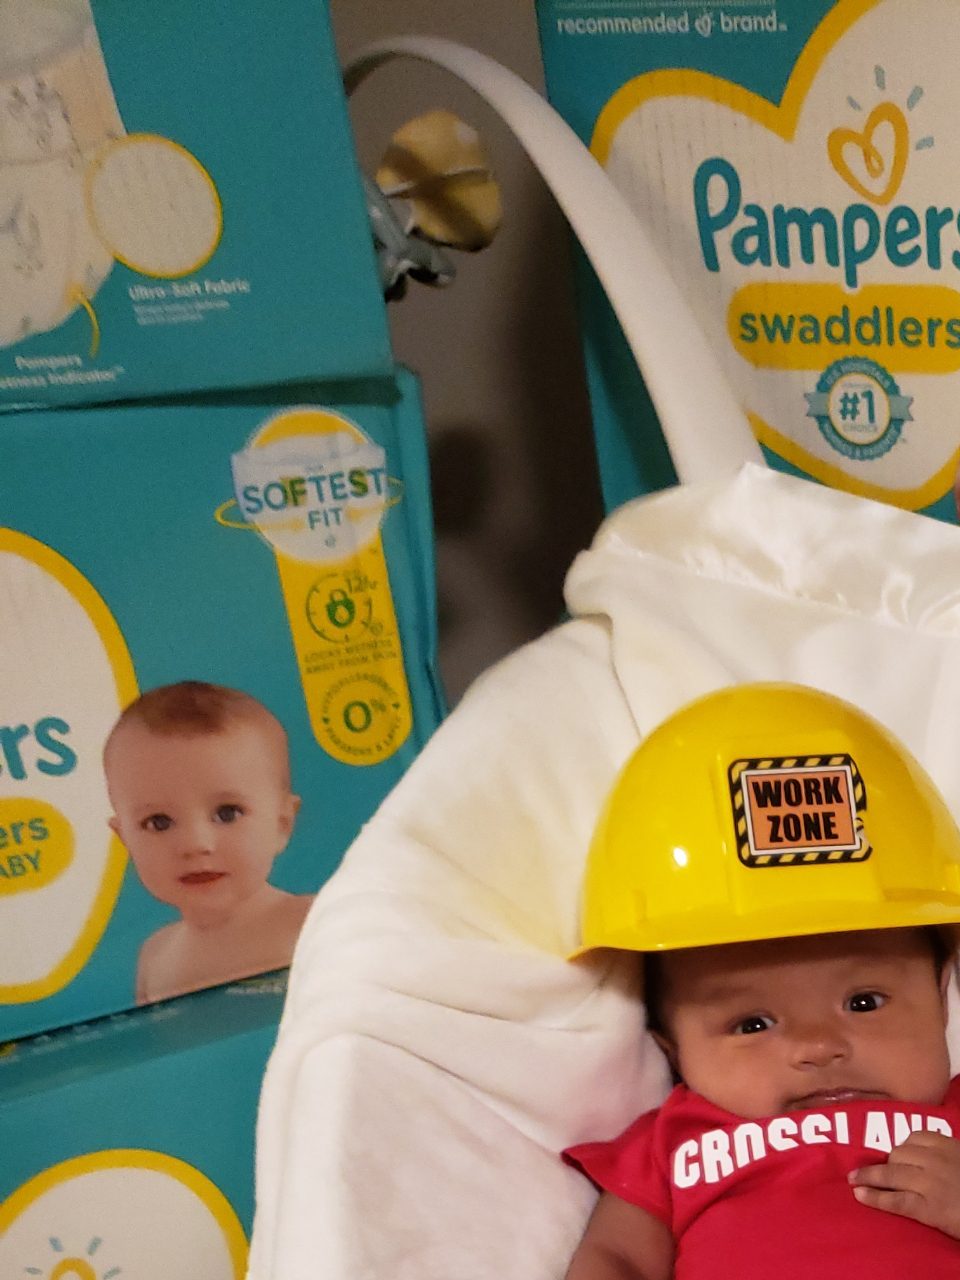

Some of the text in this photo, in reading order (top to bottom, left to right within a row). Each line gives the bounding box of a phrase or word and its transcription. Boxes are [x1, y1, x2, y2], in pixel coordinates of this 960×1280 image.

[557, 12, 689, 34] recommended
[839, 389, 876, 424] #1
[243, 468, 385, 515] SOFTEST
[308, 508, 343, 530] FIT
[751, 776, 844, 808] WORK
[767, 812, 839, 843] ZONE
